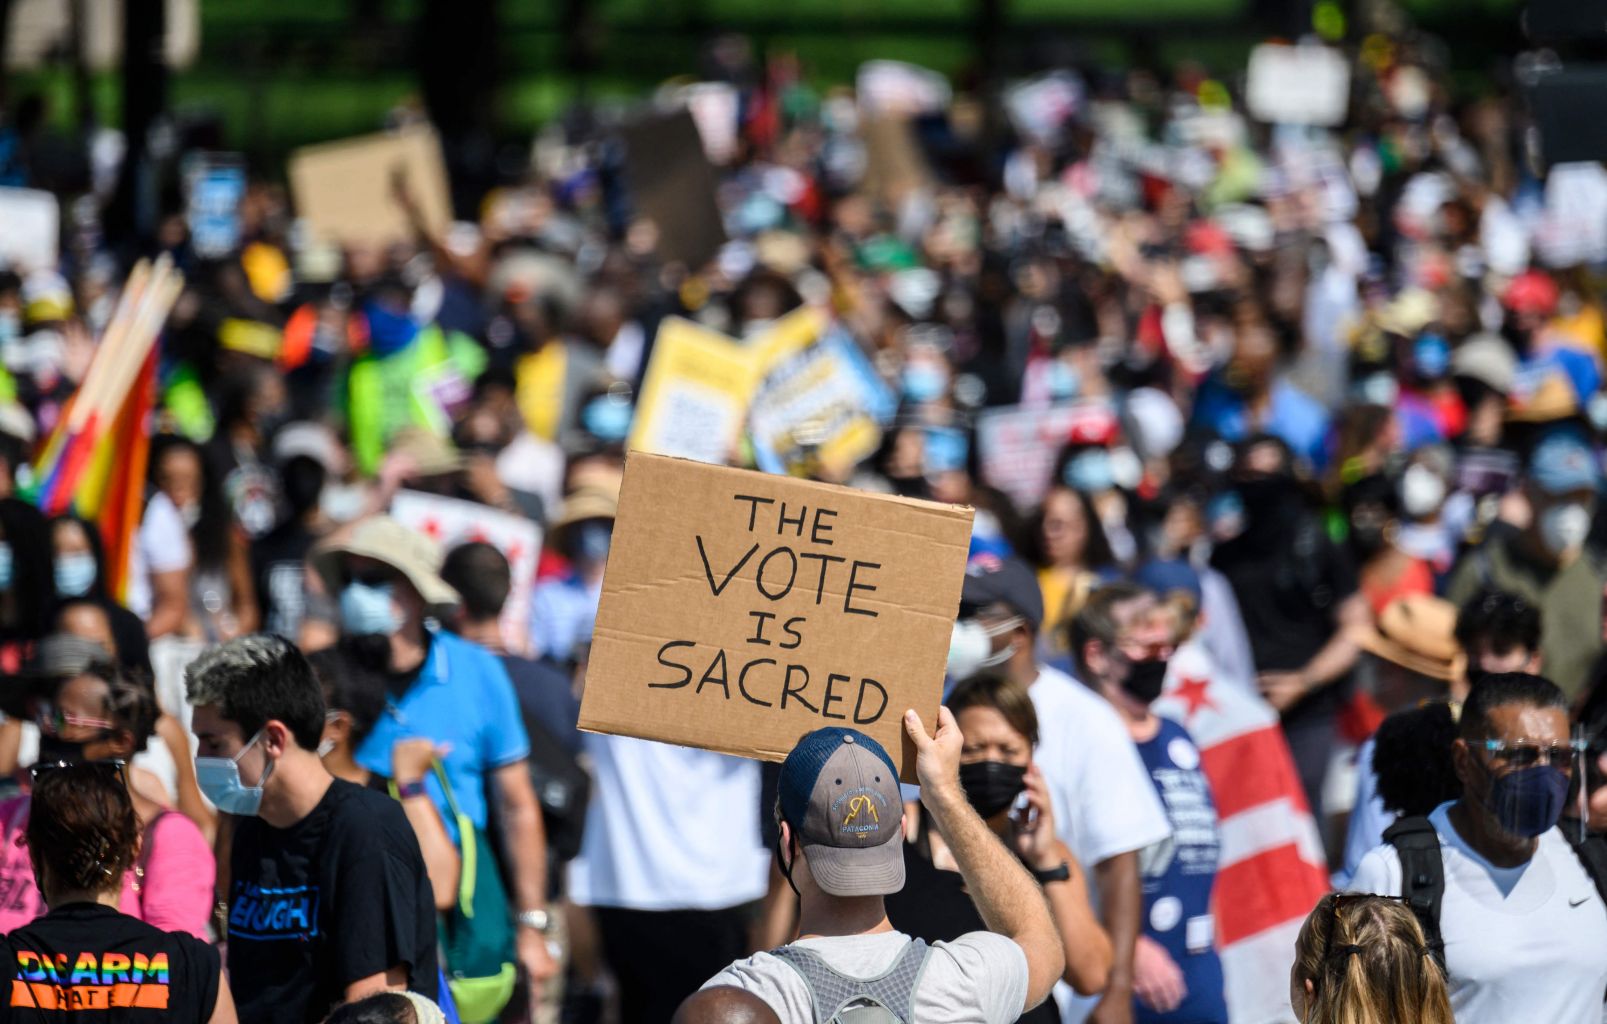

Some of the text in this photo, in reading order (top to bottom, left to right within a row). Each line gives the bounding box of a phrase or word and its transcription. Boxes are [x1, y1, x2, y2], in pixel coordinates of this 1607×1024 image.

[734, 495, 837, 546] THE
[696, 536, 881, 617] VOTE
[747, 612, 806, 649] IS
[648, 641, 888, 725] SACRED
[17, 950, 169, 984] DISARM
[56, 989, 115, 1007] HATE
